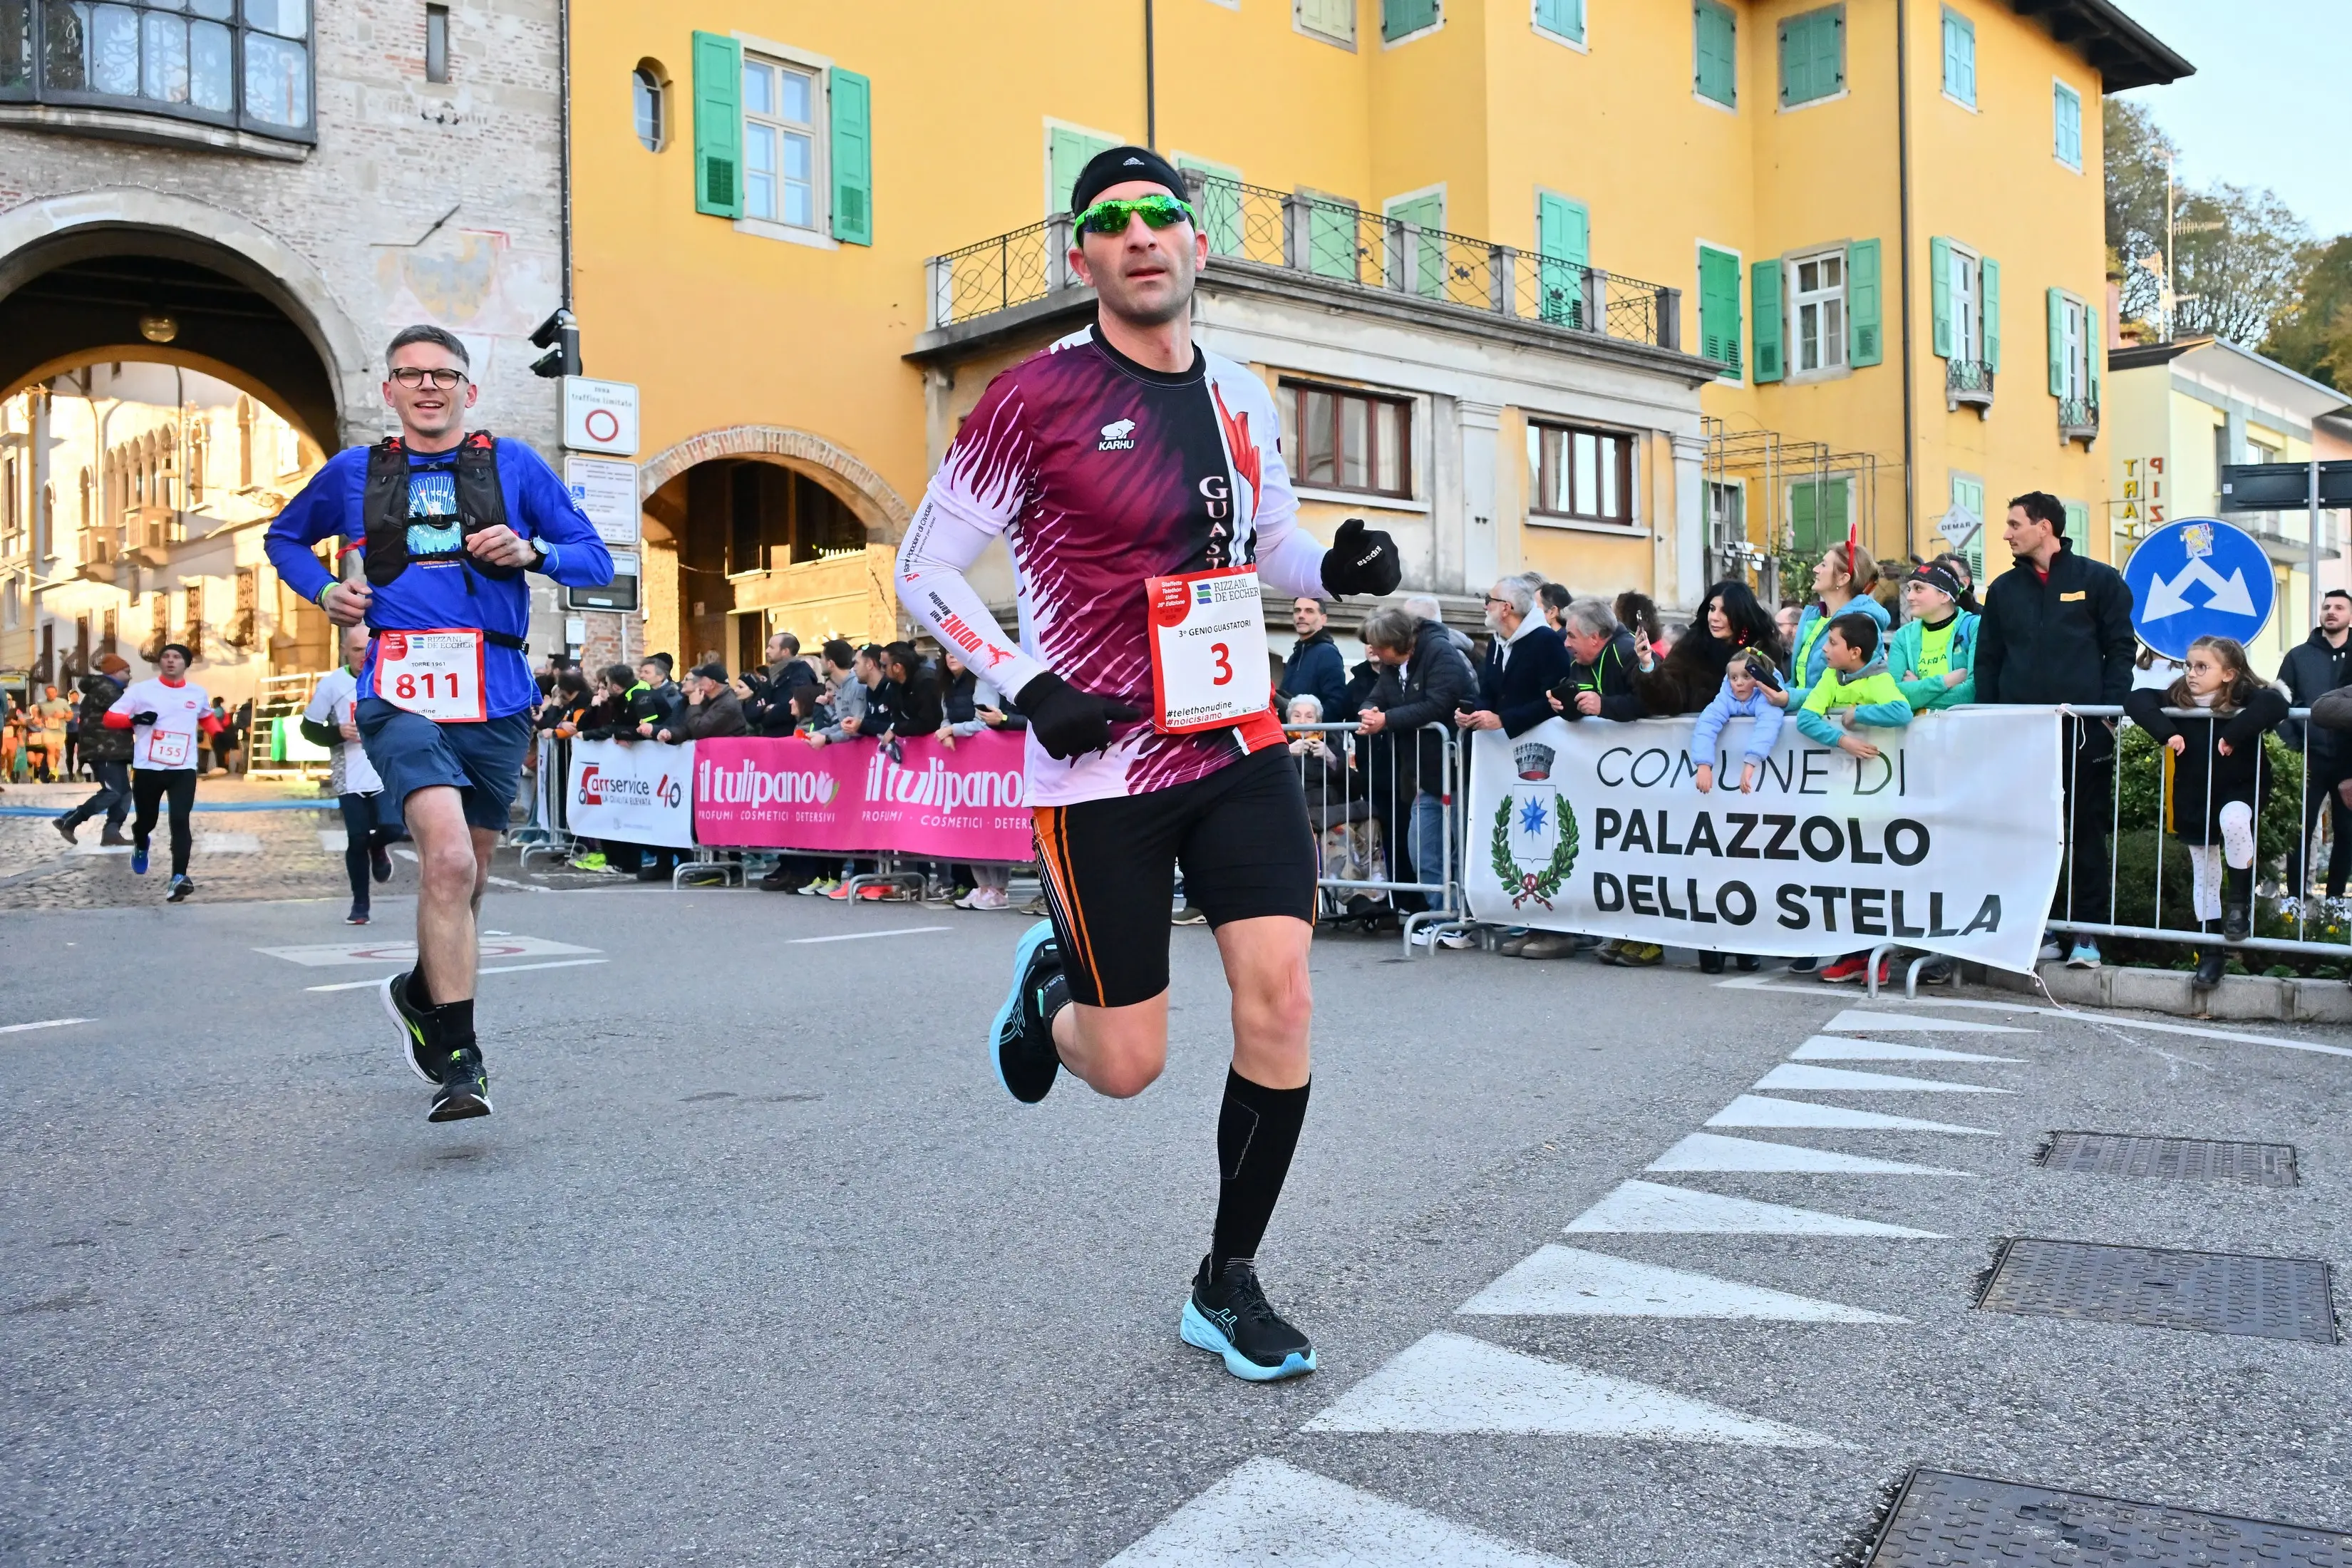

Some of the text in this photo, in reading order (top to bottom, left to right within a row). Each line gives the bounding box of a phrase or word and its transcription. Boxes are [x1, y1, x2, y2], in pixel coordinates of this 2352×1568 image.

[572, 393, 632, 407] traffico limitato
[1098, 439, 1134, 451] KARHU
[920, 502, 934, 526] Cividale
[1941, 522, 1971, 531] DEMAR
[1356, 545, 1383, 567] kipsta
[1937, 567, 1952, 579] TAKE
[1214, 579, 1247, 592] RIZZANI
[1215, 587, 1259, 602] DE ECCHER
[929, 591, 952, 616] Marathon
[939, 614, 983, 653] UDINE
[1189, 626, 1212, 636] GENIO
[1214, 619, 1251, 632] GUASTATORI
[1211, 643, 1232, 685] 3
[396, 672, 458, 698] 811
[1167, 701, 1232, 718] #telethonudine
[1167, 712, 1222, 726] #noicisiamo
[160, 746, 181, 757] 155
[1853, 748, 1904, 796] DI
[656, 773, 681, 809] 40
[713, 758, 816, 809] tulipano
[885, 757, 1024, 814] tulipano
[629, 798, 651, 806] ELEVATA
[698, 810, 835, 822] PROFUMI COSMETICI DETERSIVI
[862, 811, 903, 822] PROFUMI
[920, 815, 983, 829] COSMETICI
[1595, 808, 1930, 867] PALAZZOLO
[1594, 871, 2001, 939] DELLO STELLA
